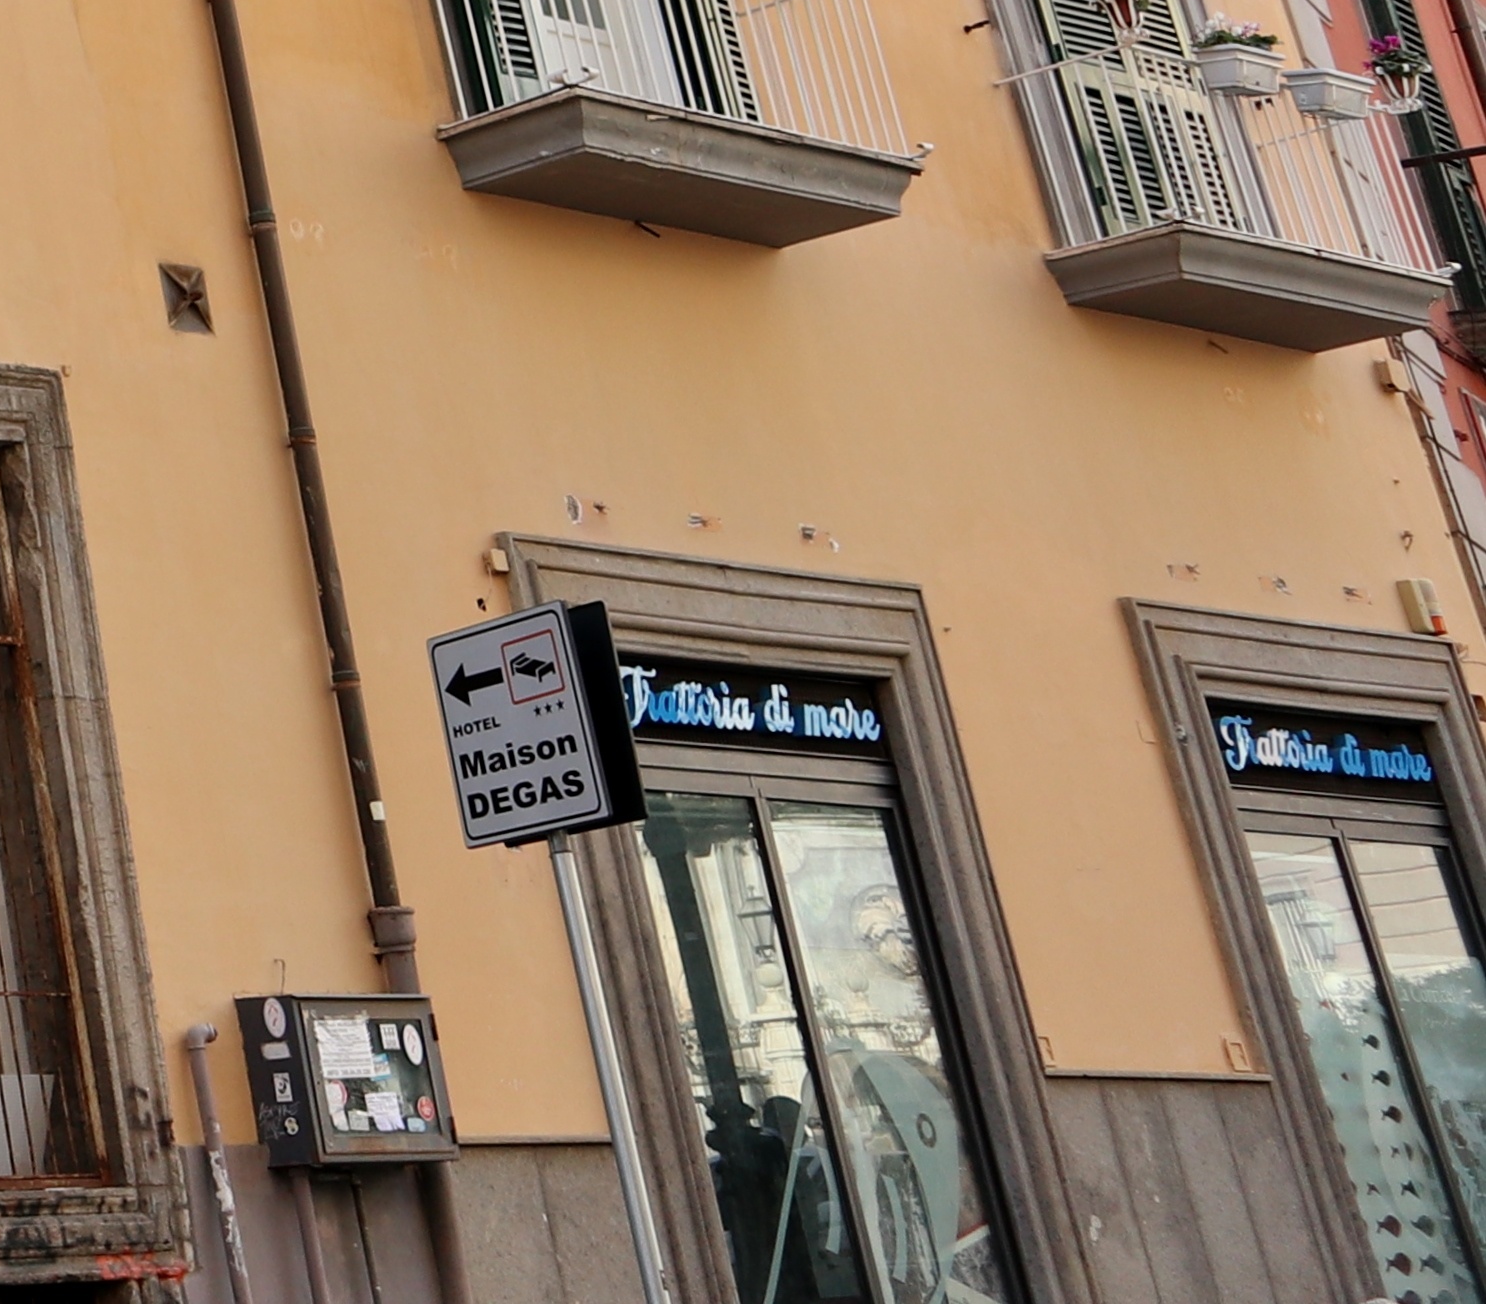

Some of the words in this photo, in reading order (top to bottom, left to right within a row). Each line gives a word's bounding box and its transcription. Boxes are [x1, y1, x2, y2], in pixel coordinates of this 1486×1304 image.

[452, 715, 501, 738] HOTEL
[619, 665, 755, 732] Trattoria
[763, 683, 795, 734] di
[804, 697, 881, 742] mare
[459, 733, 578, 780] Maison
[1220, 715, 1333, 773] Trattoria
[1340, 732, 1366, 777] di
[1371, 744, 1432, 782] mare
[467, 769, 585, 820] DEGAS
